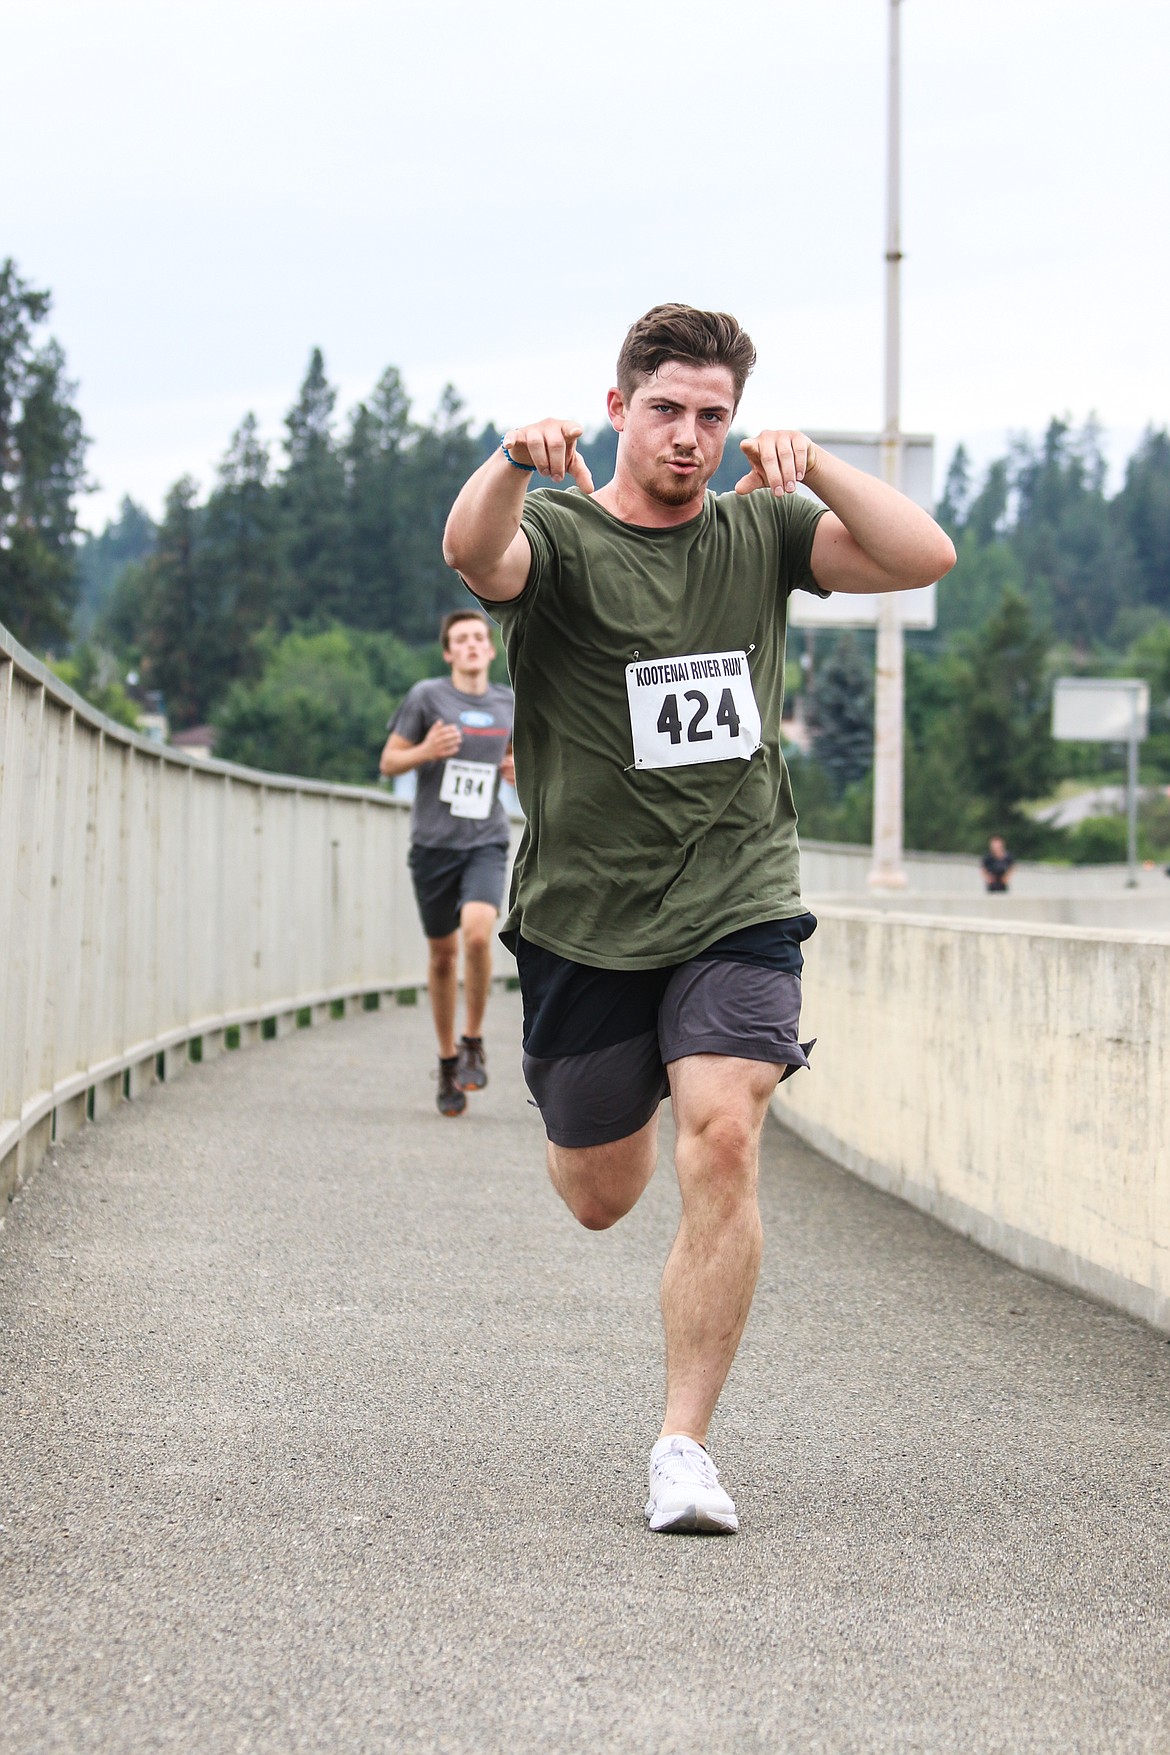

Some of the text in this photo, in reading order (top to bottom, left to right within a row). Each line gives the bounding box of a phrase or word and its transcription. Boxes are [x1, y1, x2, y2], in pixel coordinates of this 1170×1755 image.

[636, 657, 742, 687] KOOTENAI RIVER RUN
[656, 687, 741, 745] 424
